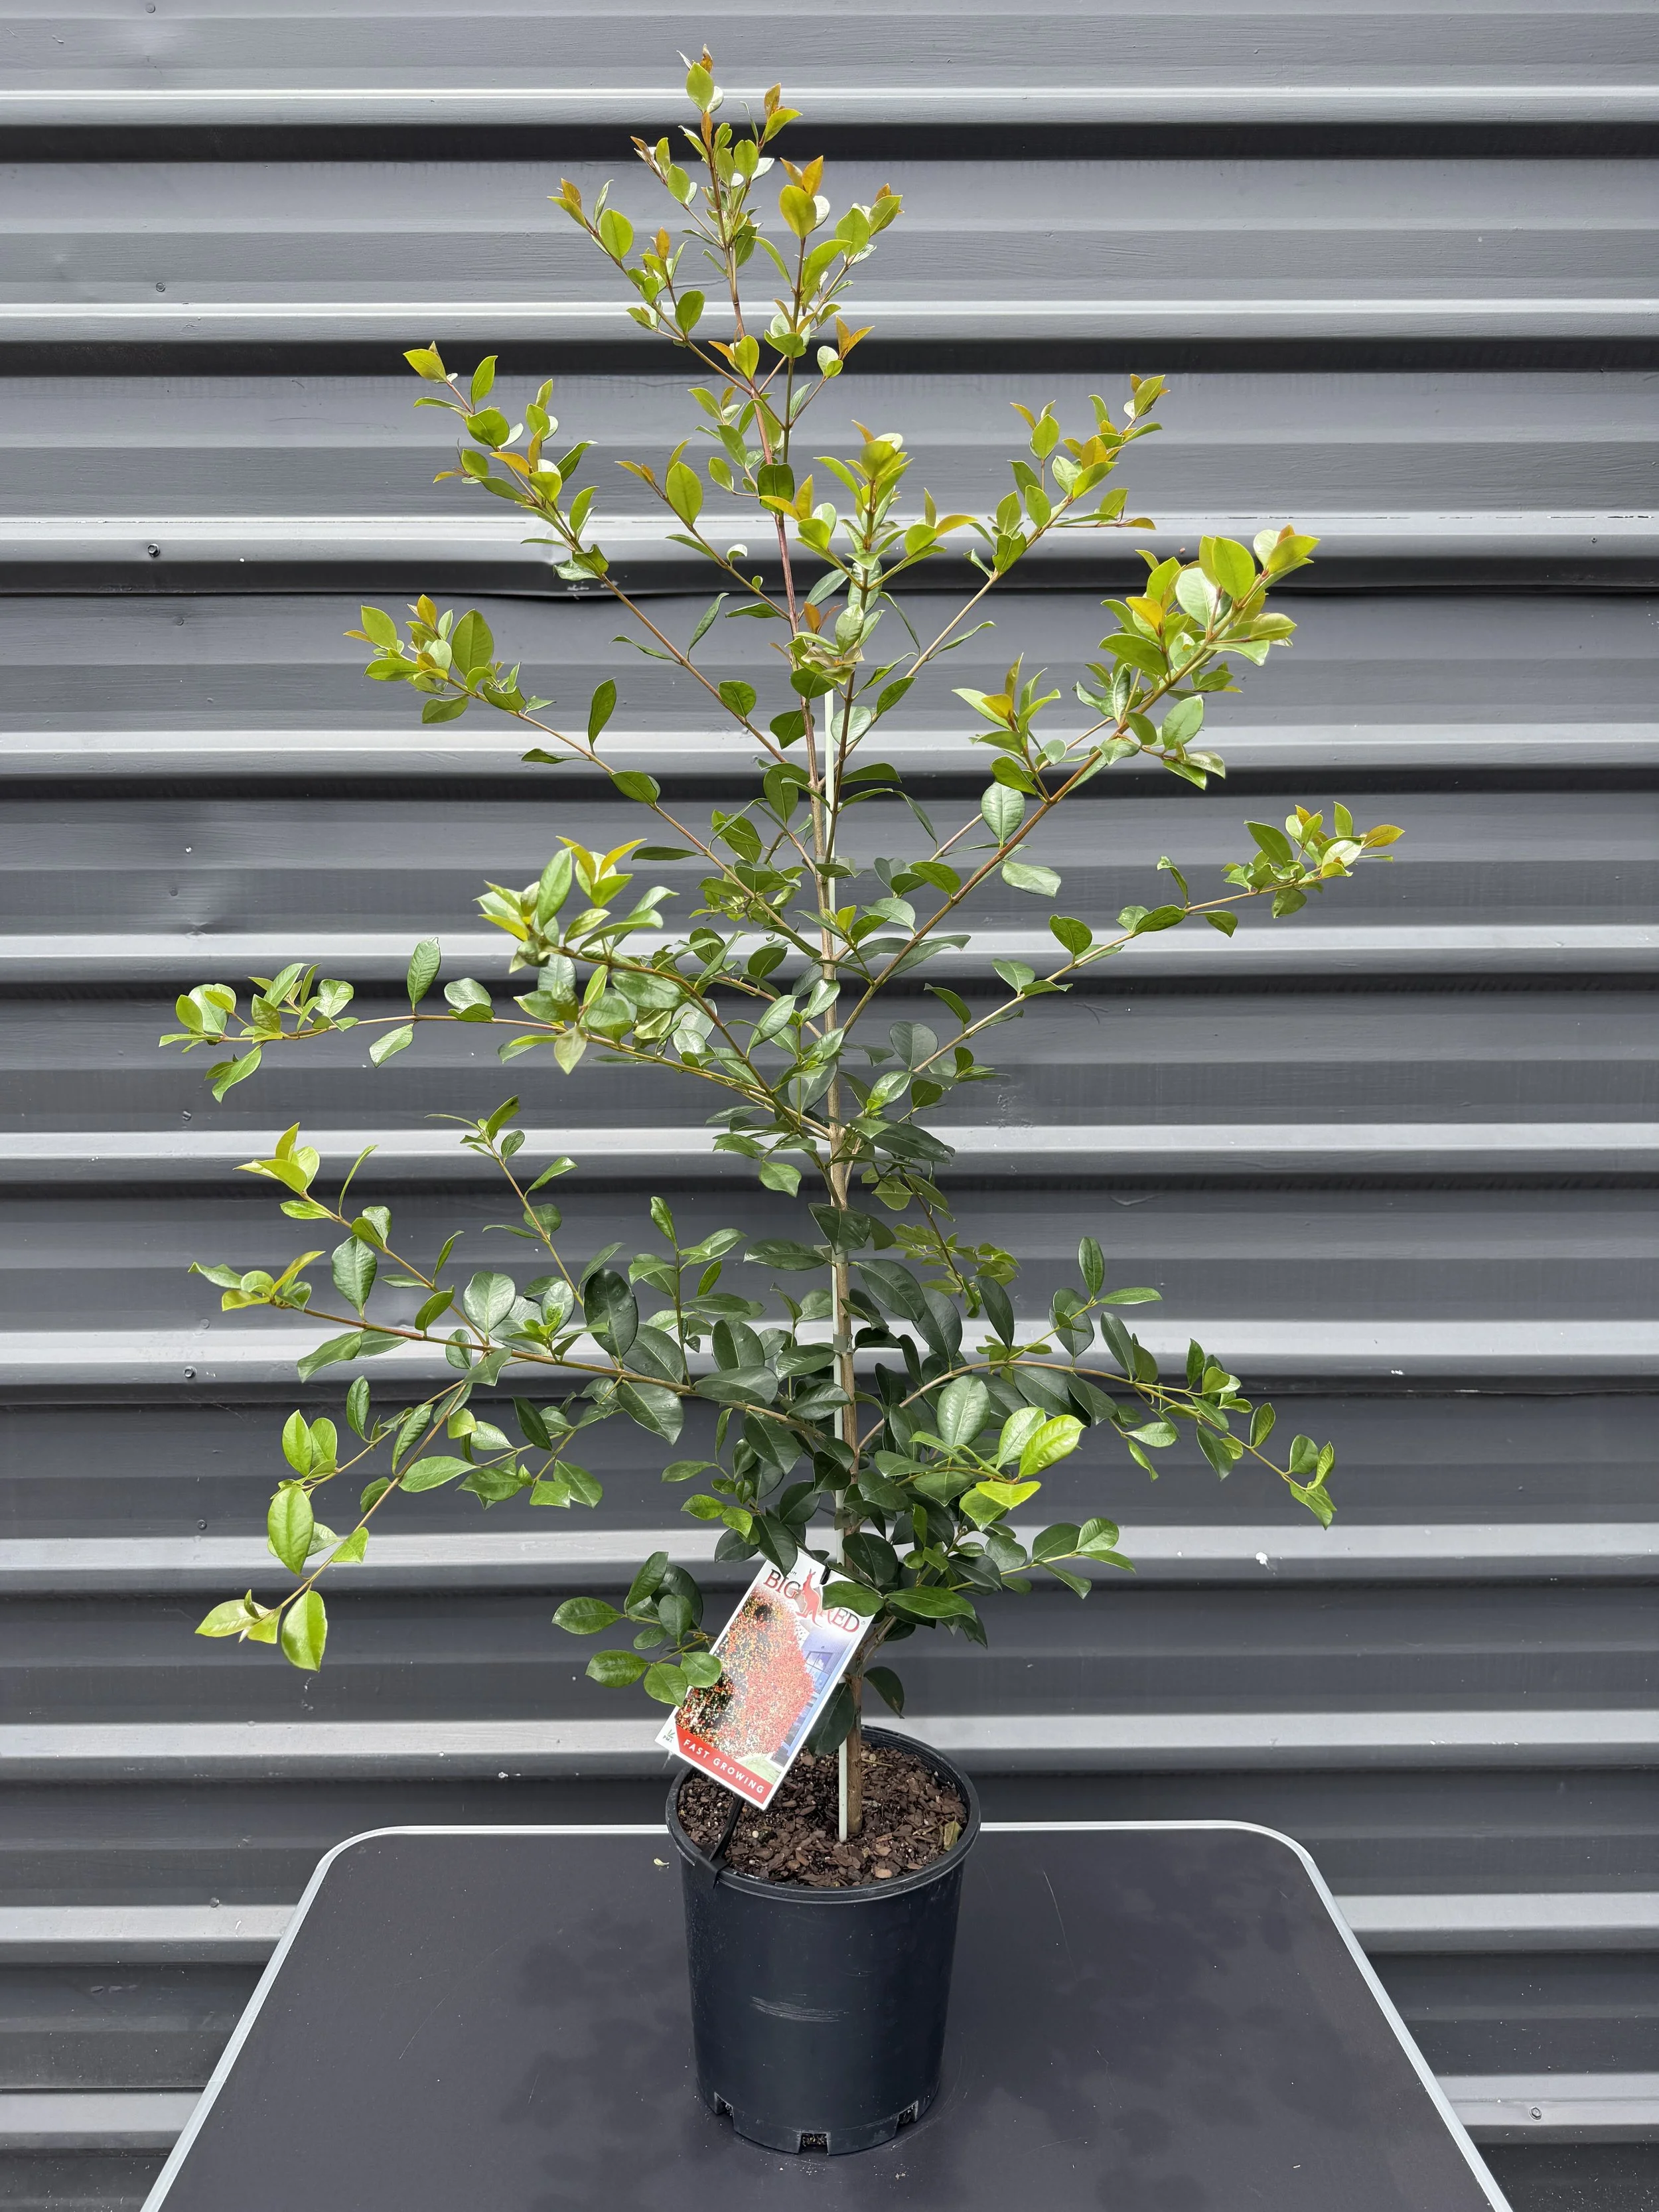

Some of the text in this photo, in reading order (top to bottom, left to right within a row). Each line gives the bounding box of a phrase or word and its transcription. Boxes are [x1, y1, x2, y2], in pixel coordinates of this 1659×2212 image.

[763, 1568, 801, 1599] BIG
[683, 1739, 764, 1794] FAST GROWING
